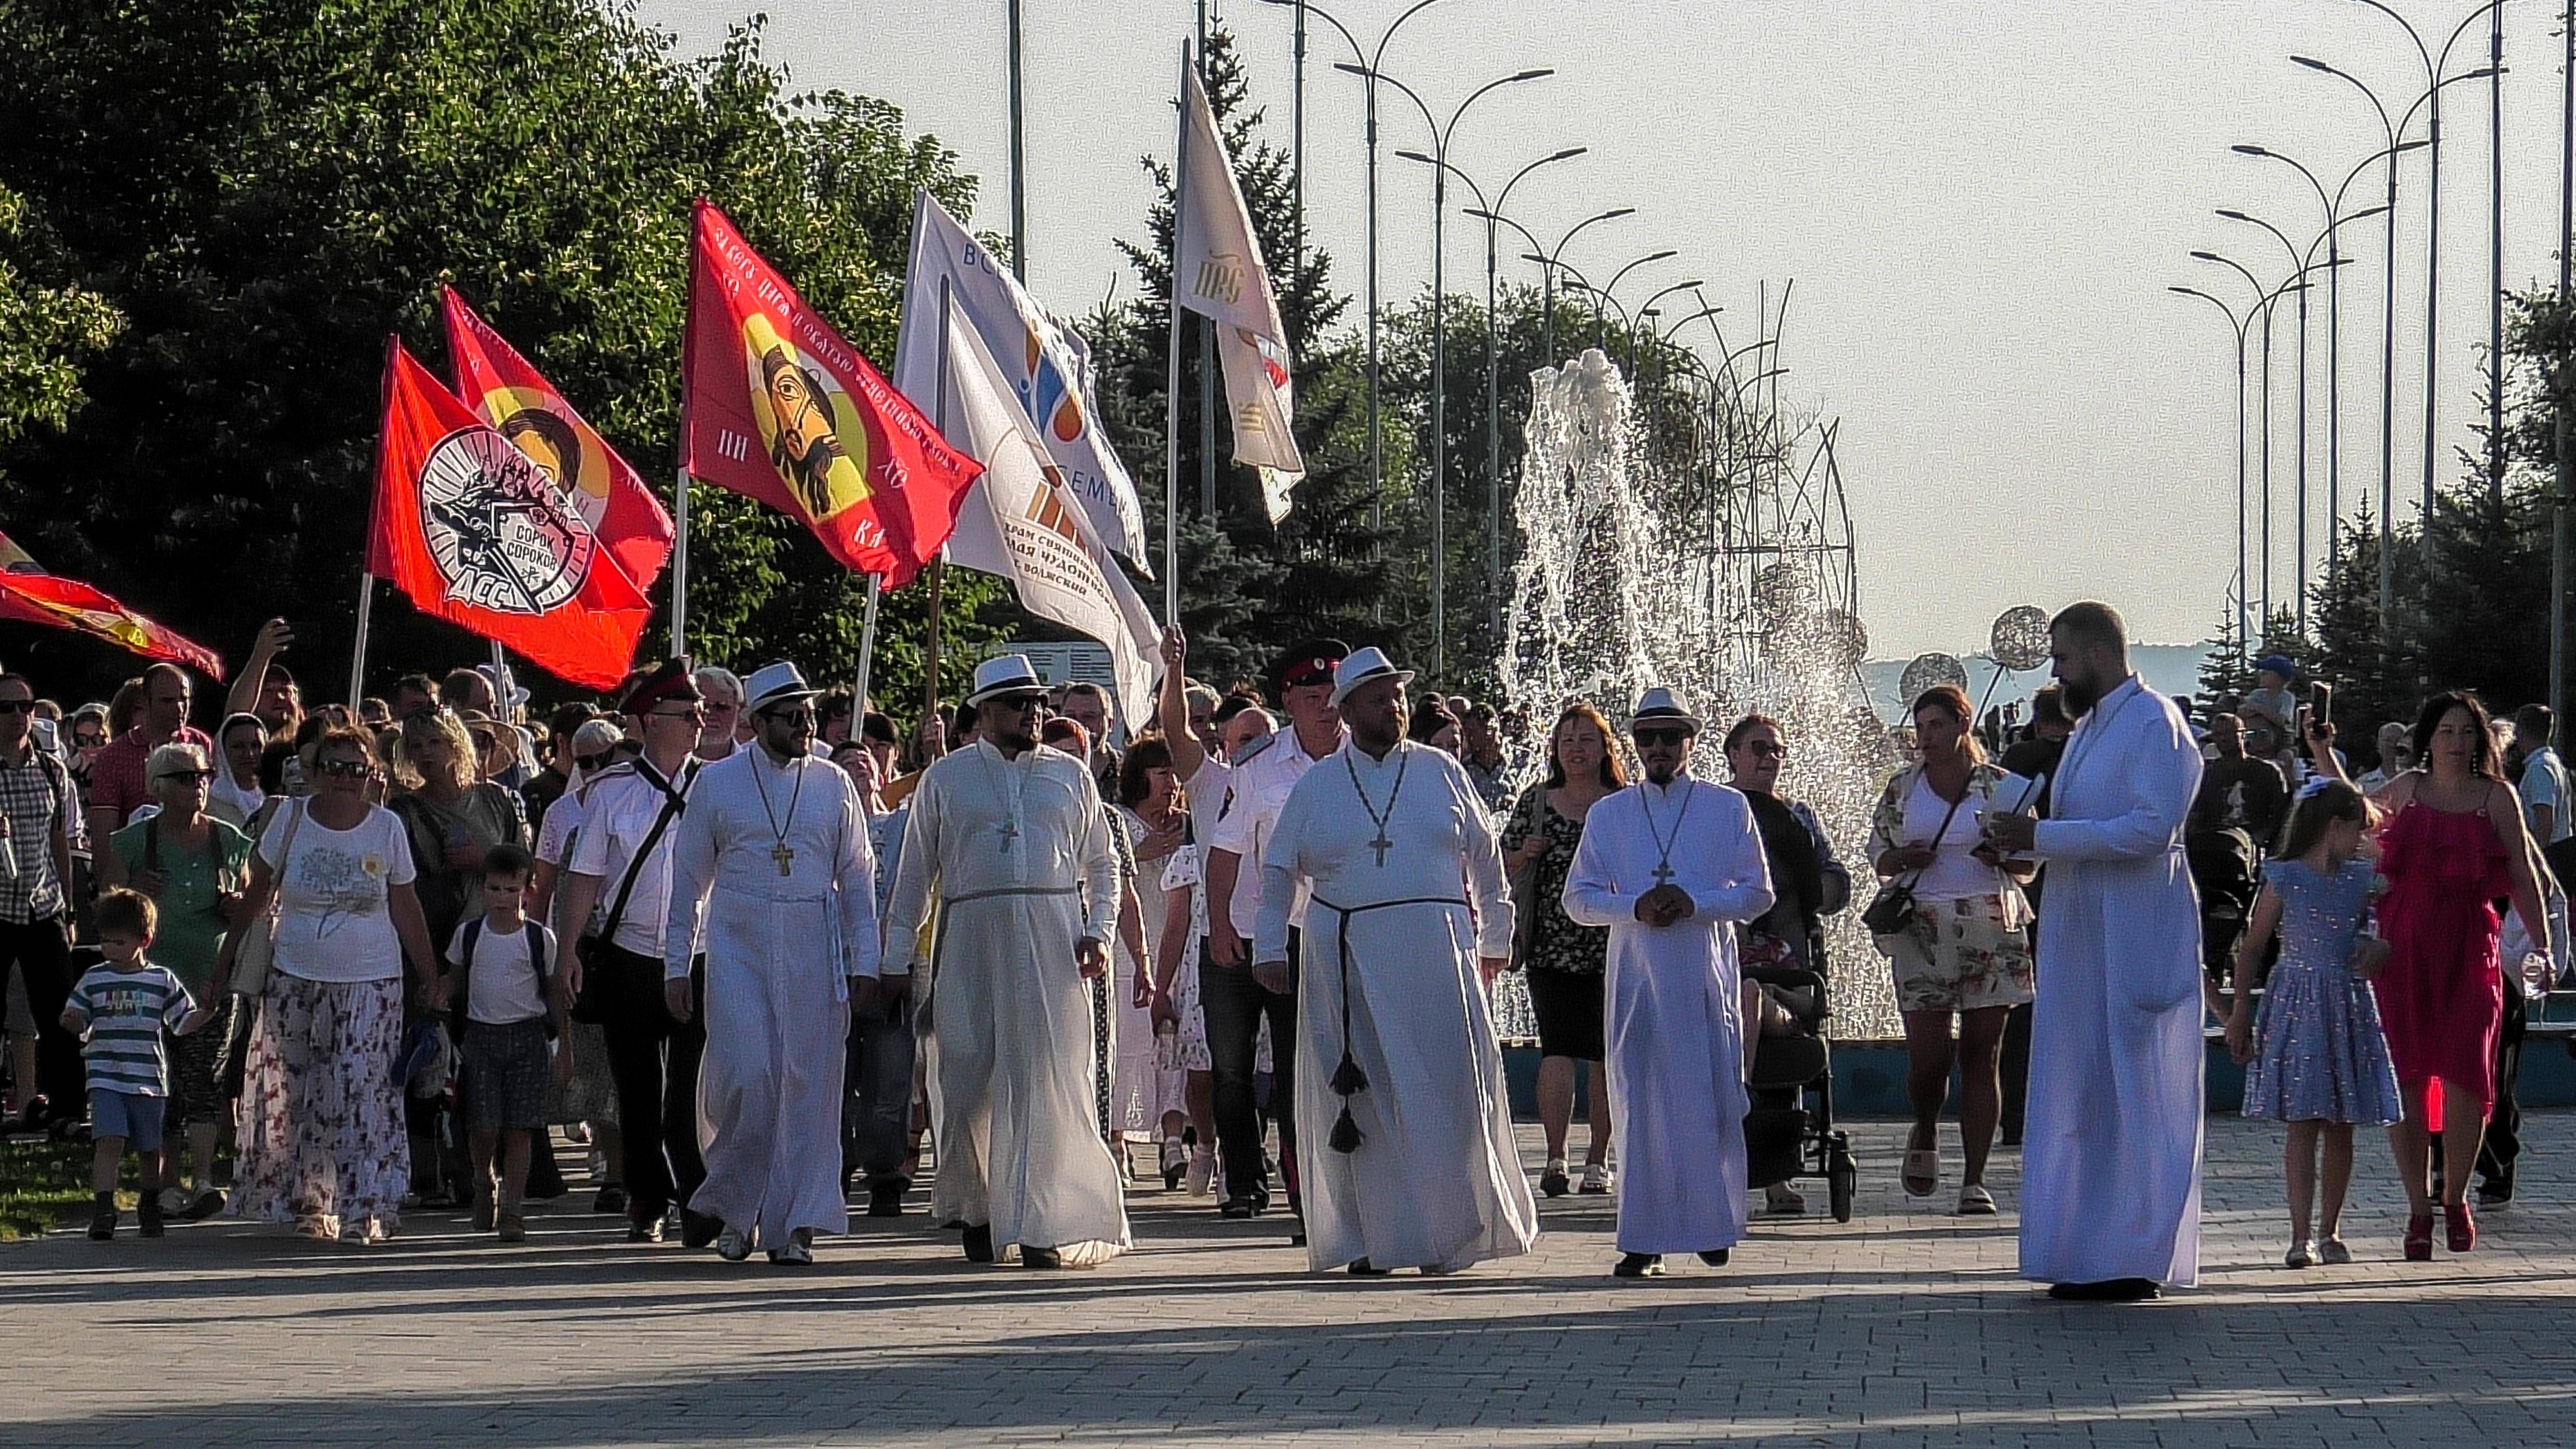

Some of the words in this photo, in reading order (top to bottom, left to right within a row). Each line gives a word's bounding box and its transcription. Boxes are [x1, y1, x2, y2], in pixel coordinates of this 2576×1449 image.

[516, 525, 554, 551] СОРОК
[1005, 522, 1035, 540] ХРАМ
[507, 543, 558, 571] СОРОКОВ
